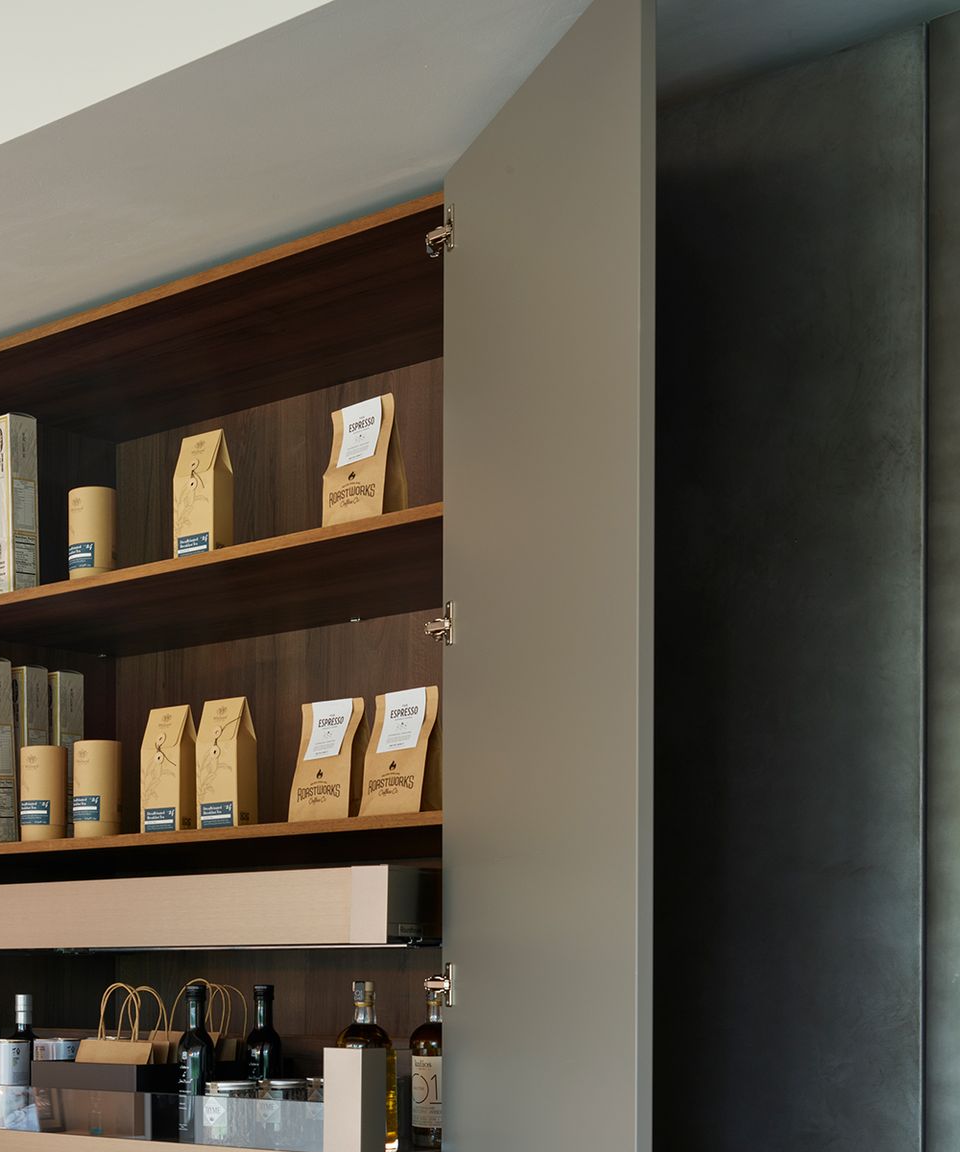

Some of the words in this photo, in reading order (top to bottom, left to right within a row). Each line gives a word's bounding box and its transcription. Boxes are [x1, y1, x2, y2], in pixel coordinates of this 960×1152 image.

[348, 416, 376, 433] ESPRESSO
[328, 483, 376, 509] ROASTWORKS
[390, 706, 419, 719] ESPRESSO
[318, 716, 345, 728] ESPRESSO
[297, 783, 341, 803] ROASTWORKS
[368, 775, 415, 795] ROASTWORKS
